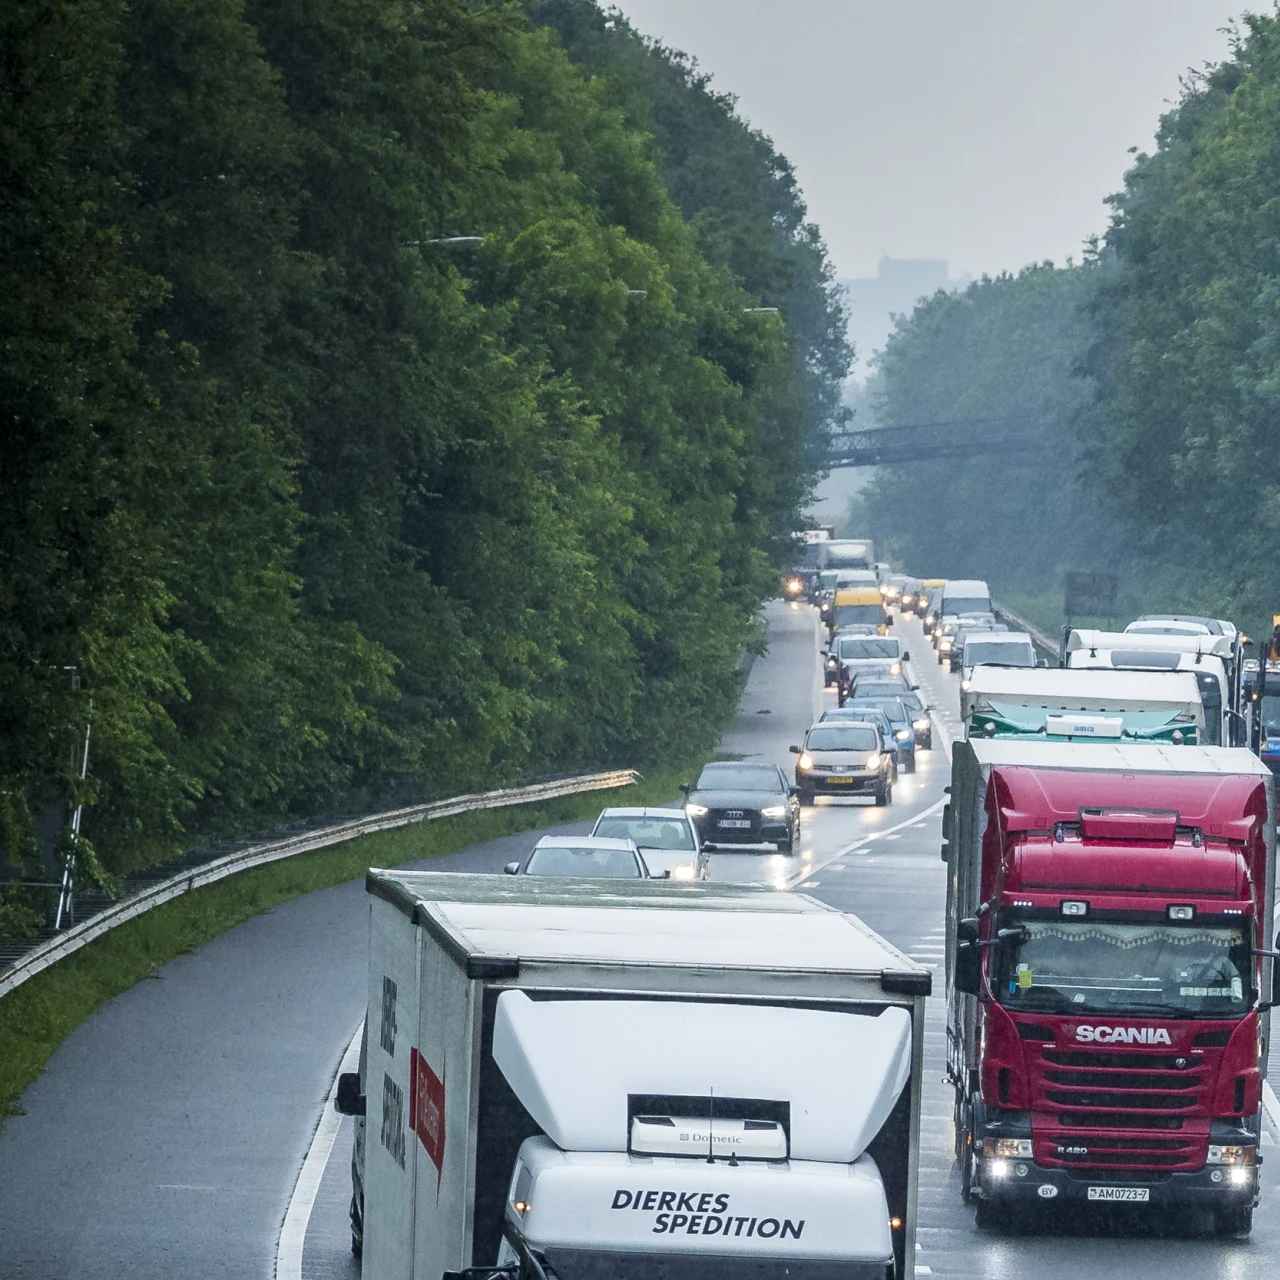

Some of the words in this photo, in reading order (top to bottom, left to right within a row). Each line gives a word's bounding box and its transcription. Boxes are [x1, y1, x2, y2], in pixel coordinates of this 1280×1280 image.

[1075, 1024, 1172, 1046] SCANIA
[692, 1133, 742, 1144] Dometic
[610, 1188, 731, 1215] DIERKES
[1041, 1187, 1055, 1196] BY
[651, 1211, 806, 1241] SPEDITION
